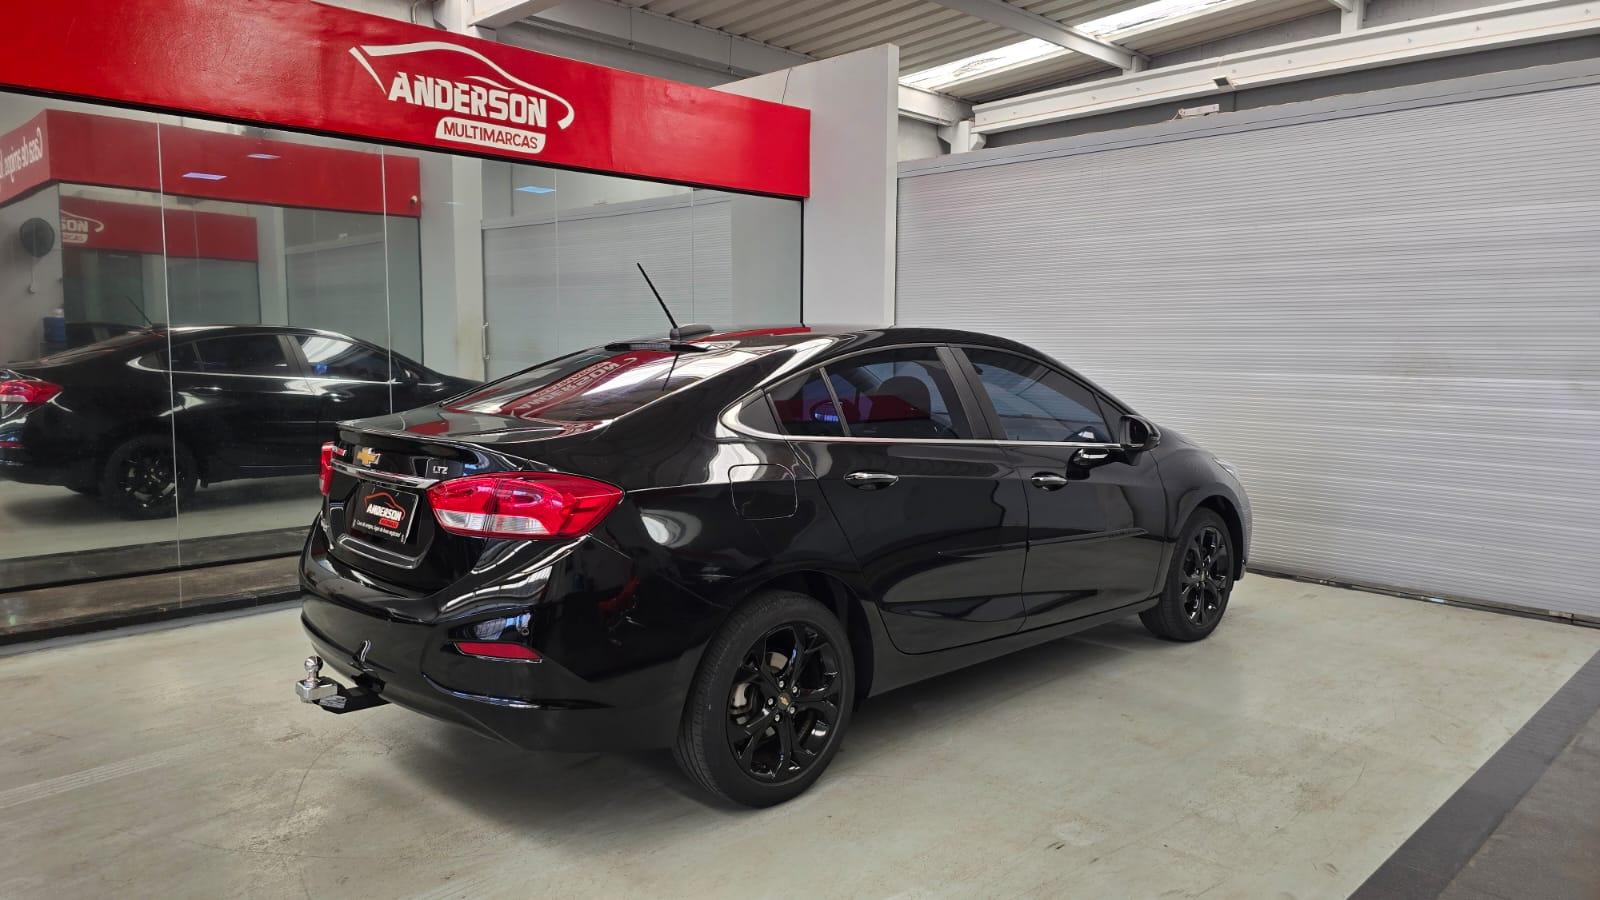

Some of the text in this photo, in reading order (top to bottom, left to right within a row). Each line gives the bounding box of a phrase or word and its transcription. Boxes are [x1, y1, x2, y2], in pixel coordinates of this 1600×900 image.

[388, 71, 547, 128] ANDERSON
[443, 120, 538, 149] MULTIMARCAS
[433, 465, 448, 475] LTZ
[366, 503, 402, 522] ANDERSON
